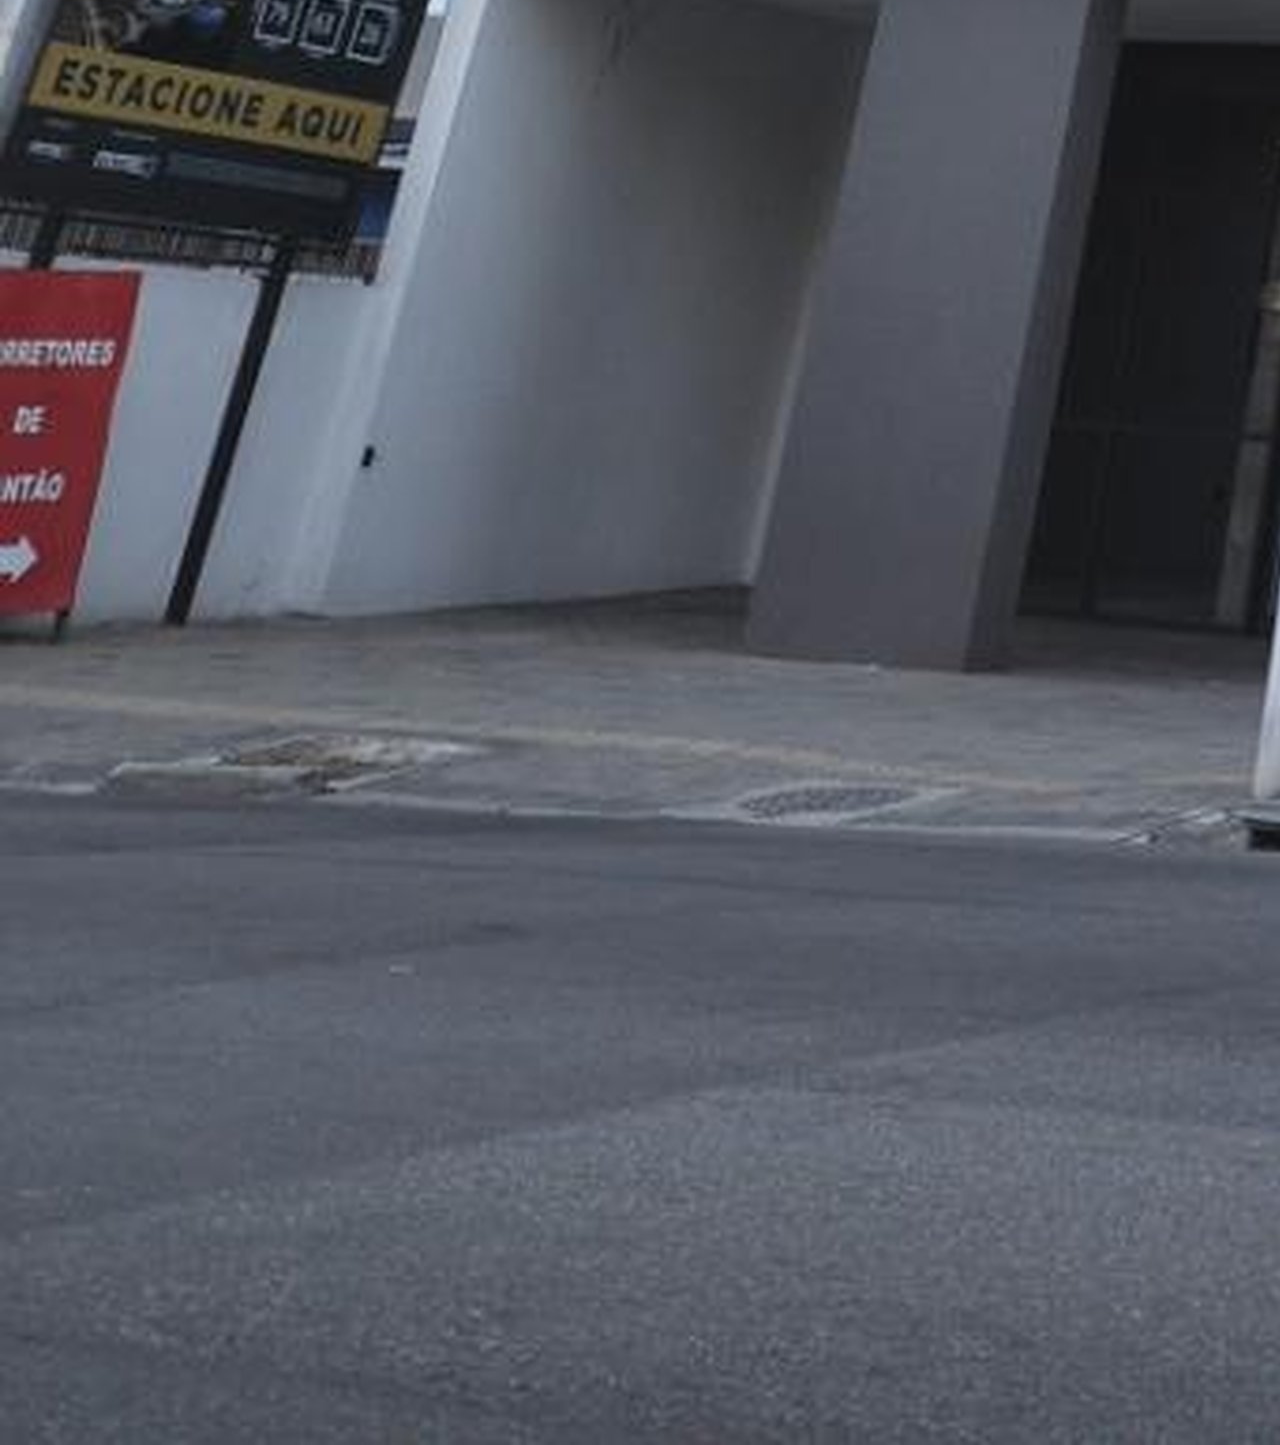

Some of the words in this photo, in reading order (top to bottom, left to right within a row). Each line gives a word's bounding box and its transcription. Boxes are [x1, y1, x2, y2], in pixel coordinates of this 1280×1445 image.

[52, 58, 266, 128] ESTACIONE
[275, 102, 367, 145] AQUI
[0, 337, 116, 367] RRETORES
[13, 405, 46, 435] DE
[0, 467, 65, 502] NTÃO
